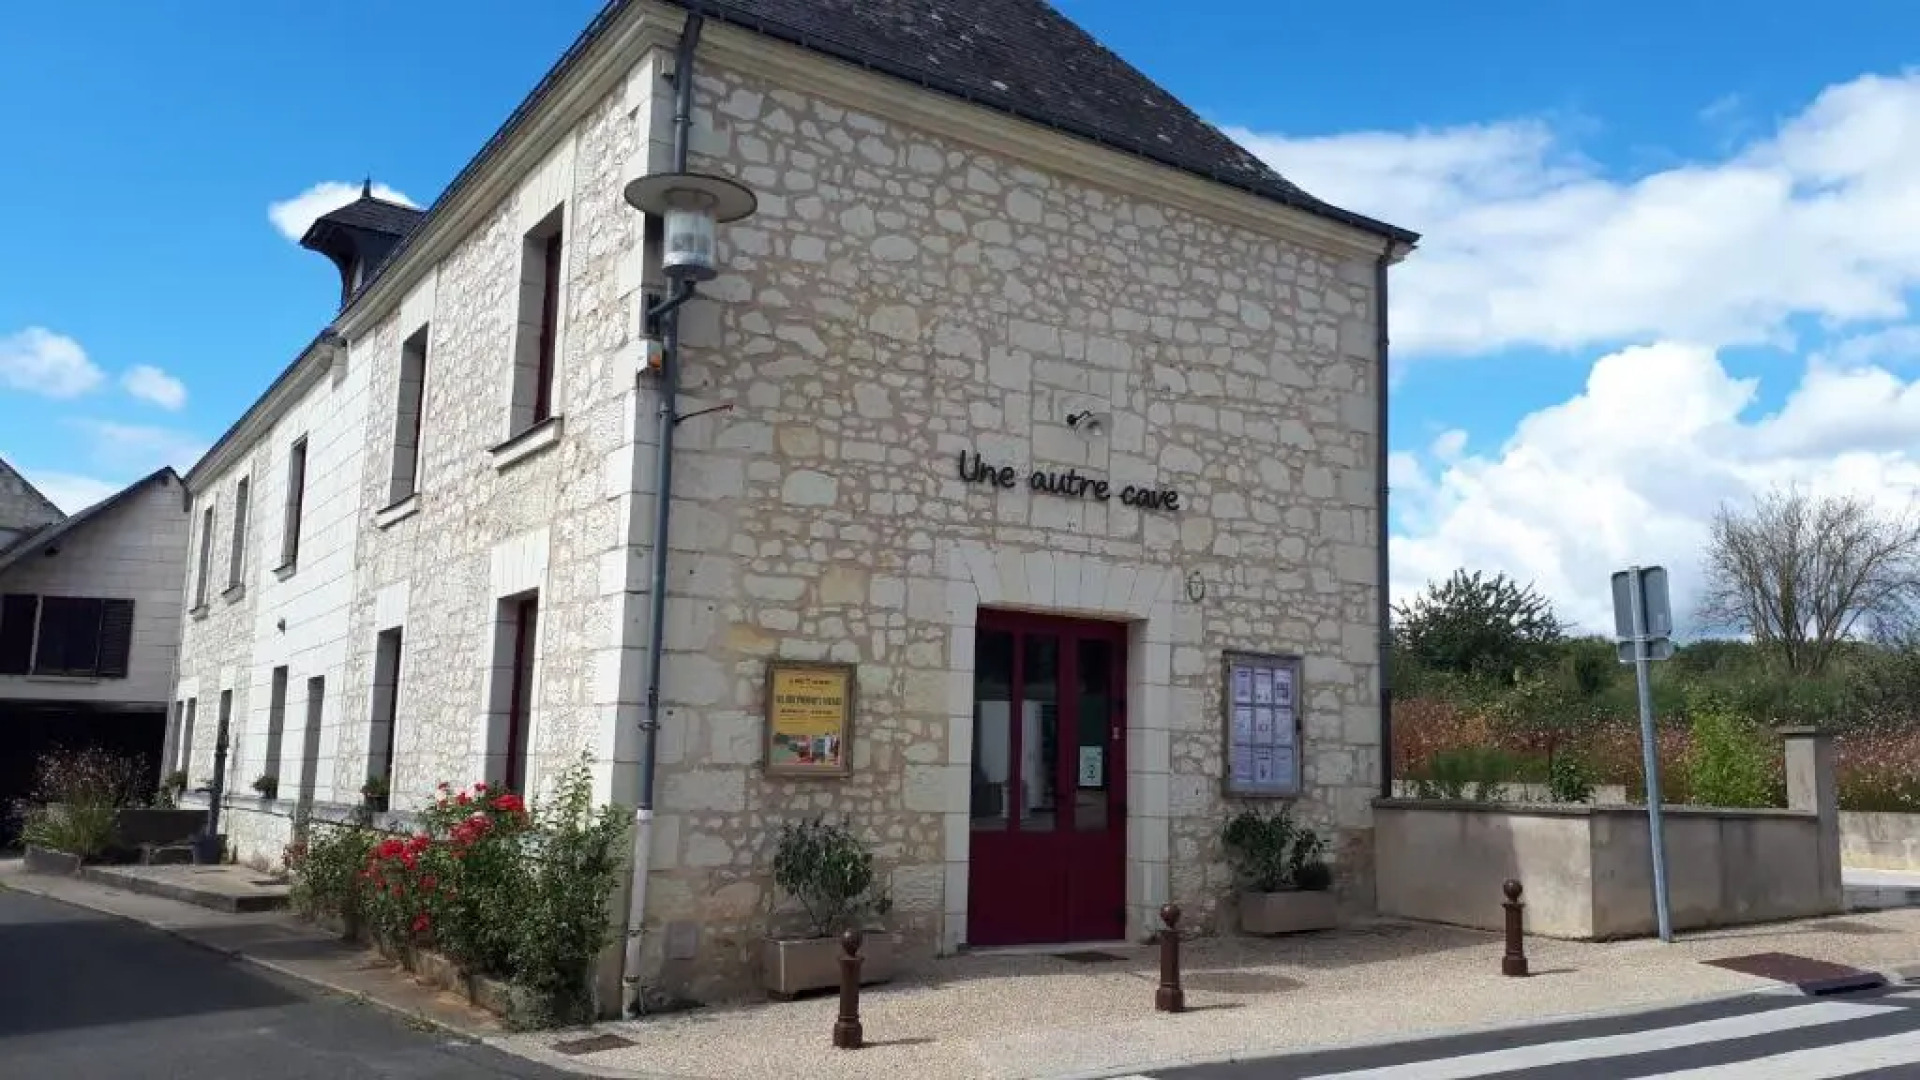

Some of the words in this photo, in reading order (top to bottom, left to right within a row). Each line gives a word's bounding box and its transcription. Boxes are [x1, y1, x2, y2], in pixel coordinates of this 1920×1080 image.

[959, 449, 1016, 488] Une
[1030, 468, 1111, 501] autre
[1120, 484, 1181, 511] cave
